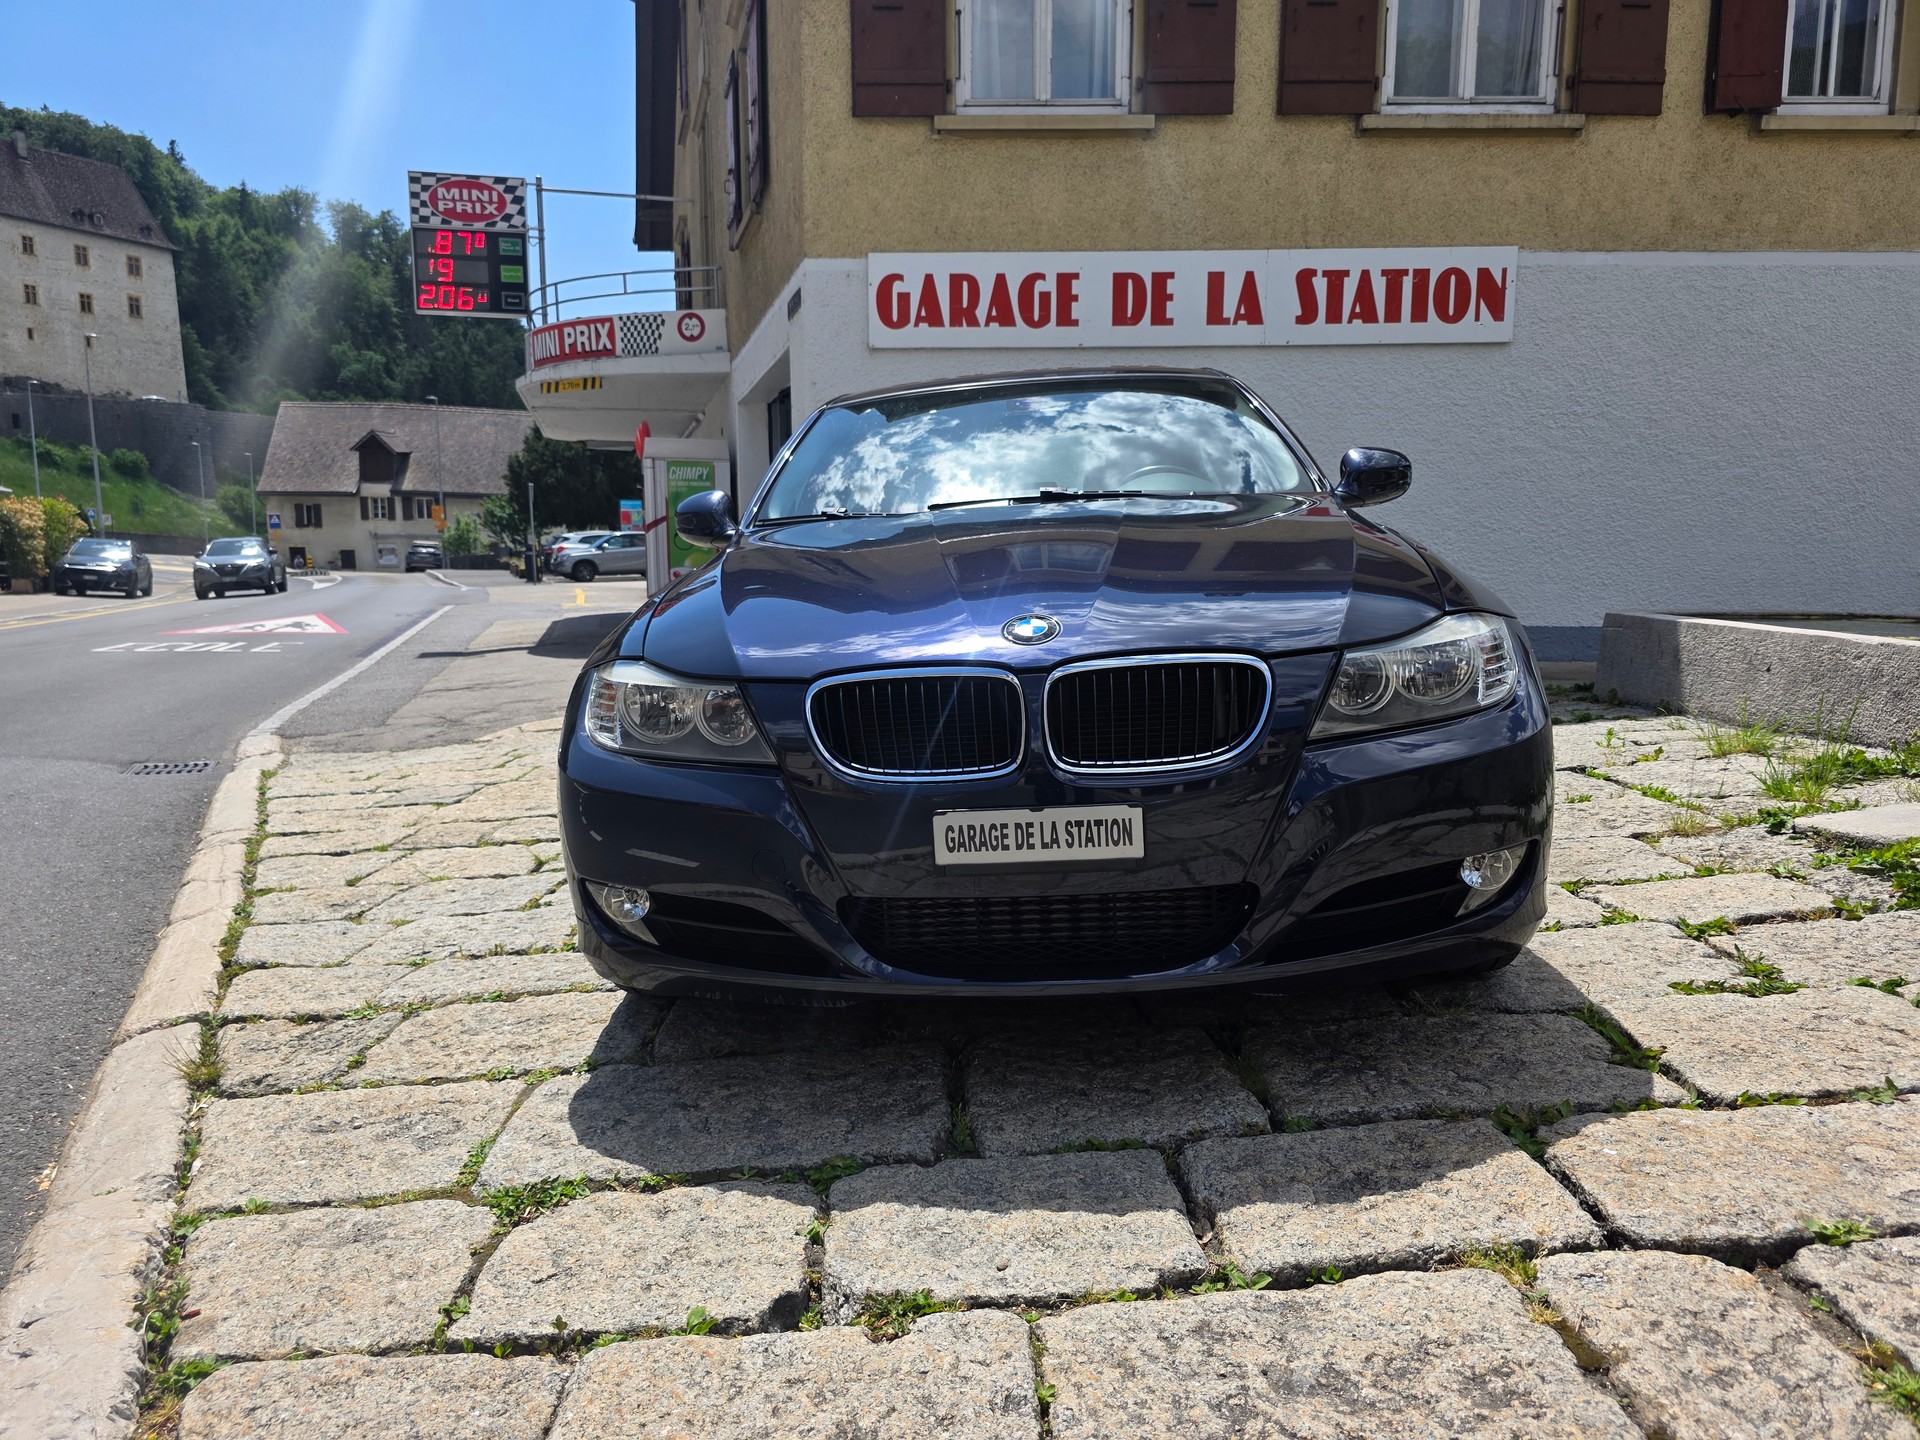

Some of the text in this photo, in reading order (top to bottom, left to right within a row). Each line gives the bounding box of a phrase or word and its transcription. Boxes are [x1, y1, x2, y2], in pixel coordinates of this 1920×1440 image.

[437, 187, 499, 203] MINI
[437, 200, 500, 216] PRIX
[876, 266, 1508, 330] GARAGE DE LA STATION
[533, 322, 613, 363] MINI PRIX
[669, 466, 709, 480] CHIMPY
[91, 641, 305, 652] ECOLE
[944, 818, 1134, 854] GARAGE DE LA STATION
